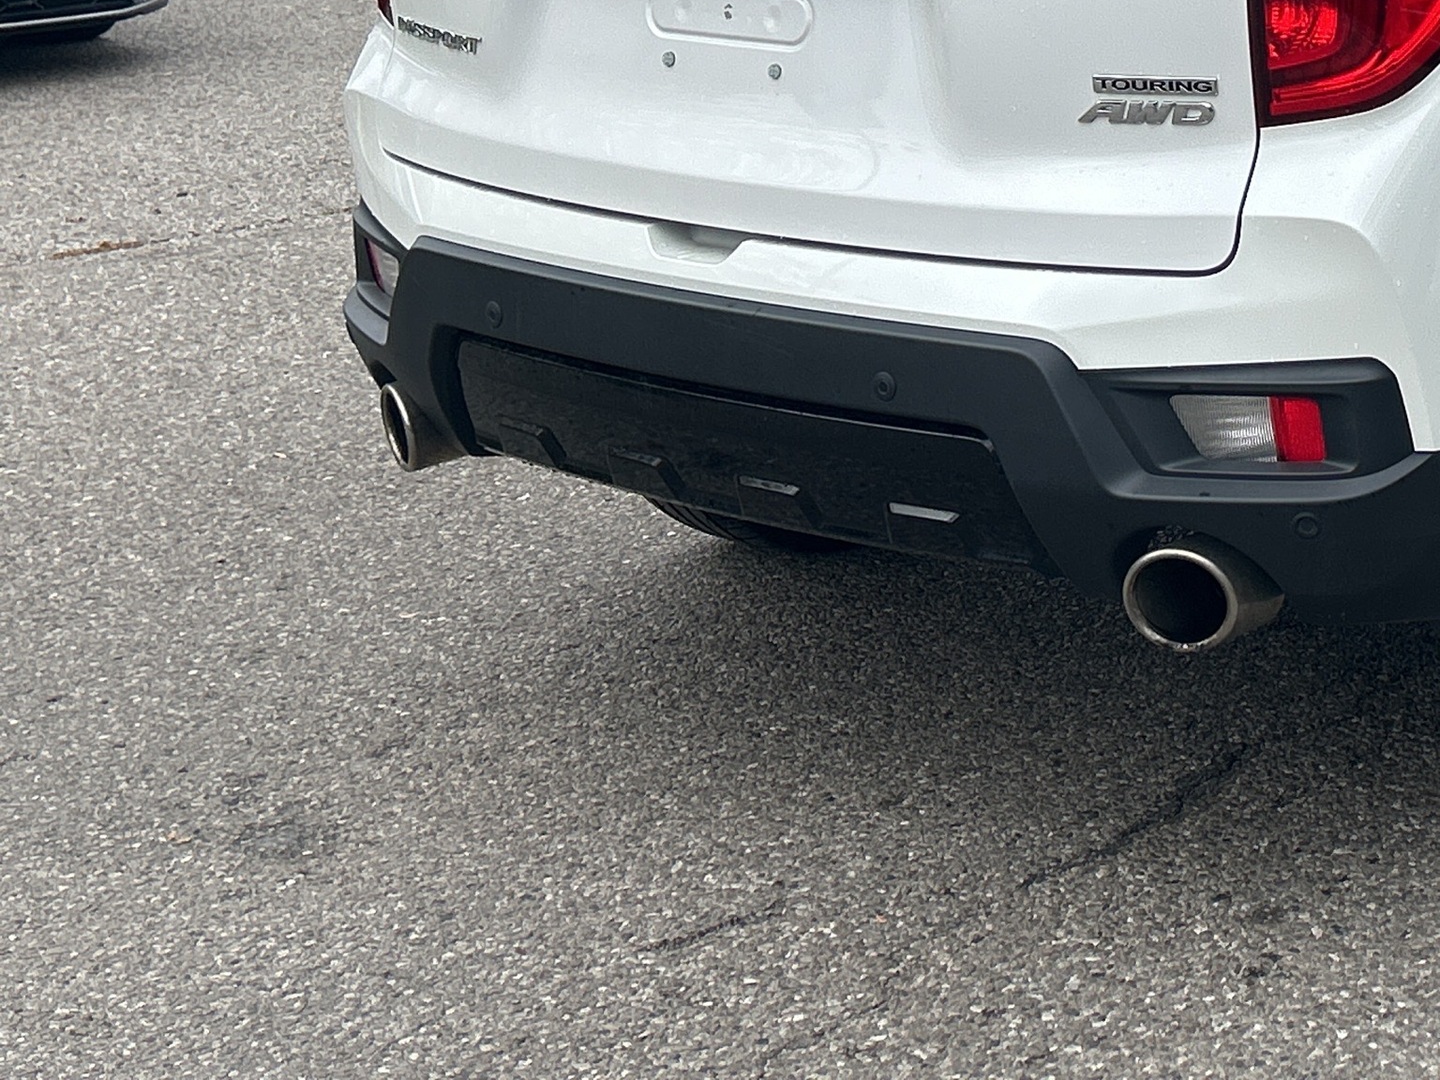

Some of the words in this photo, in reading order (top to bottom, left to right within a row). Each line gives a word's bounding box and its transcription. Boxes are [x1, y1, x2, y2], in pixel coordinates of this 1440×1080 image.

[398, 15, 482, 55] PASSPORT
[1095, 78, 1213, 93] TOURING
[1078, 98, 1216, 126] AWD
